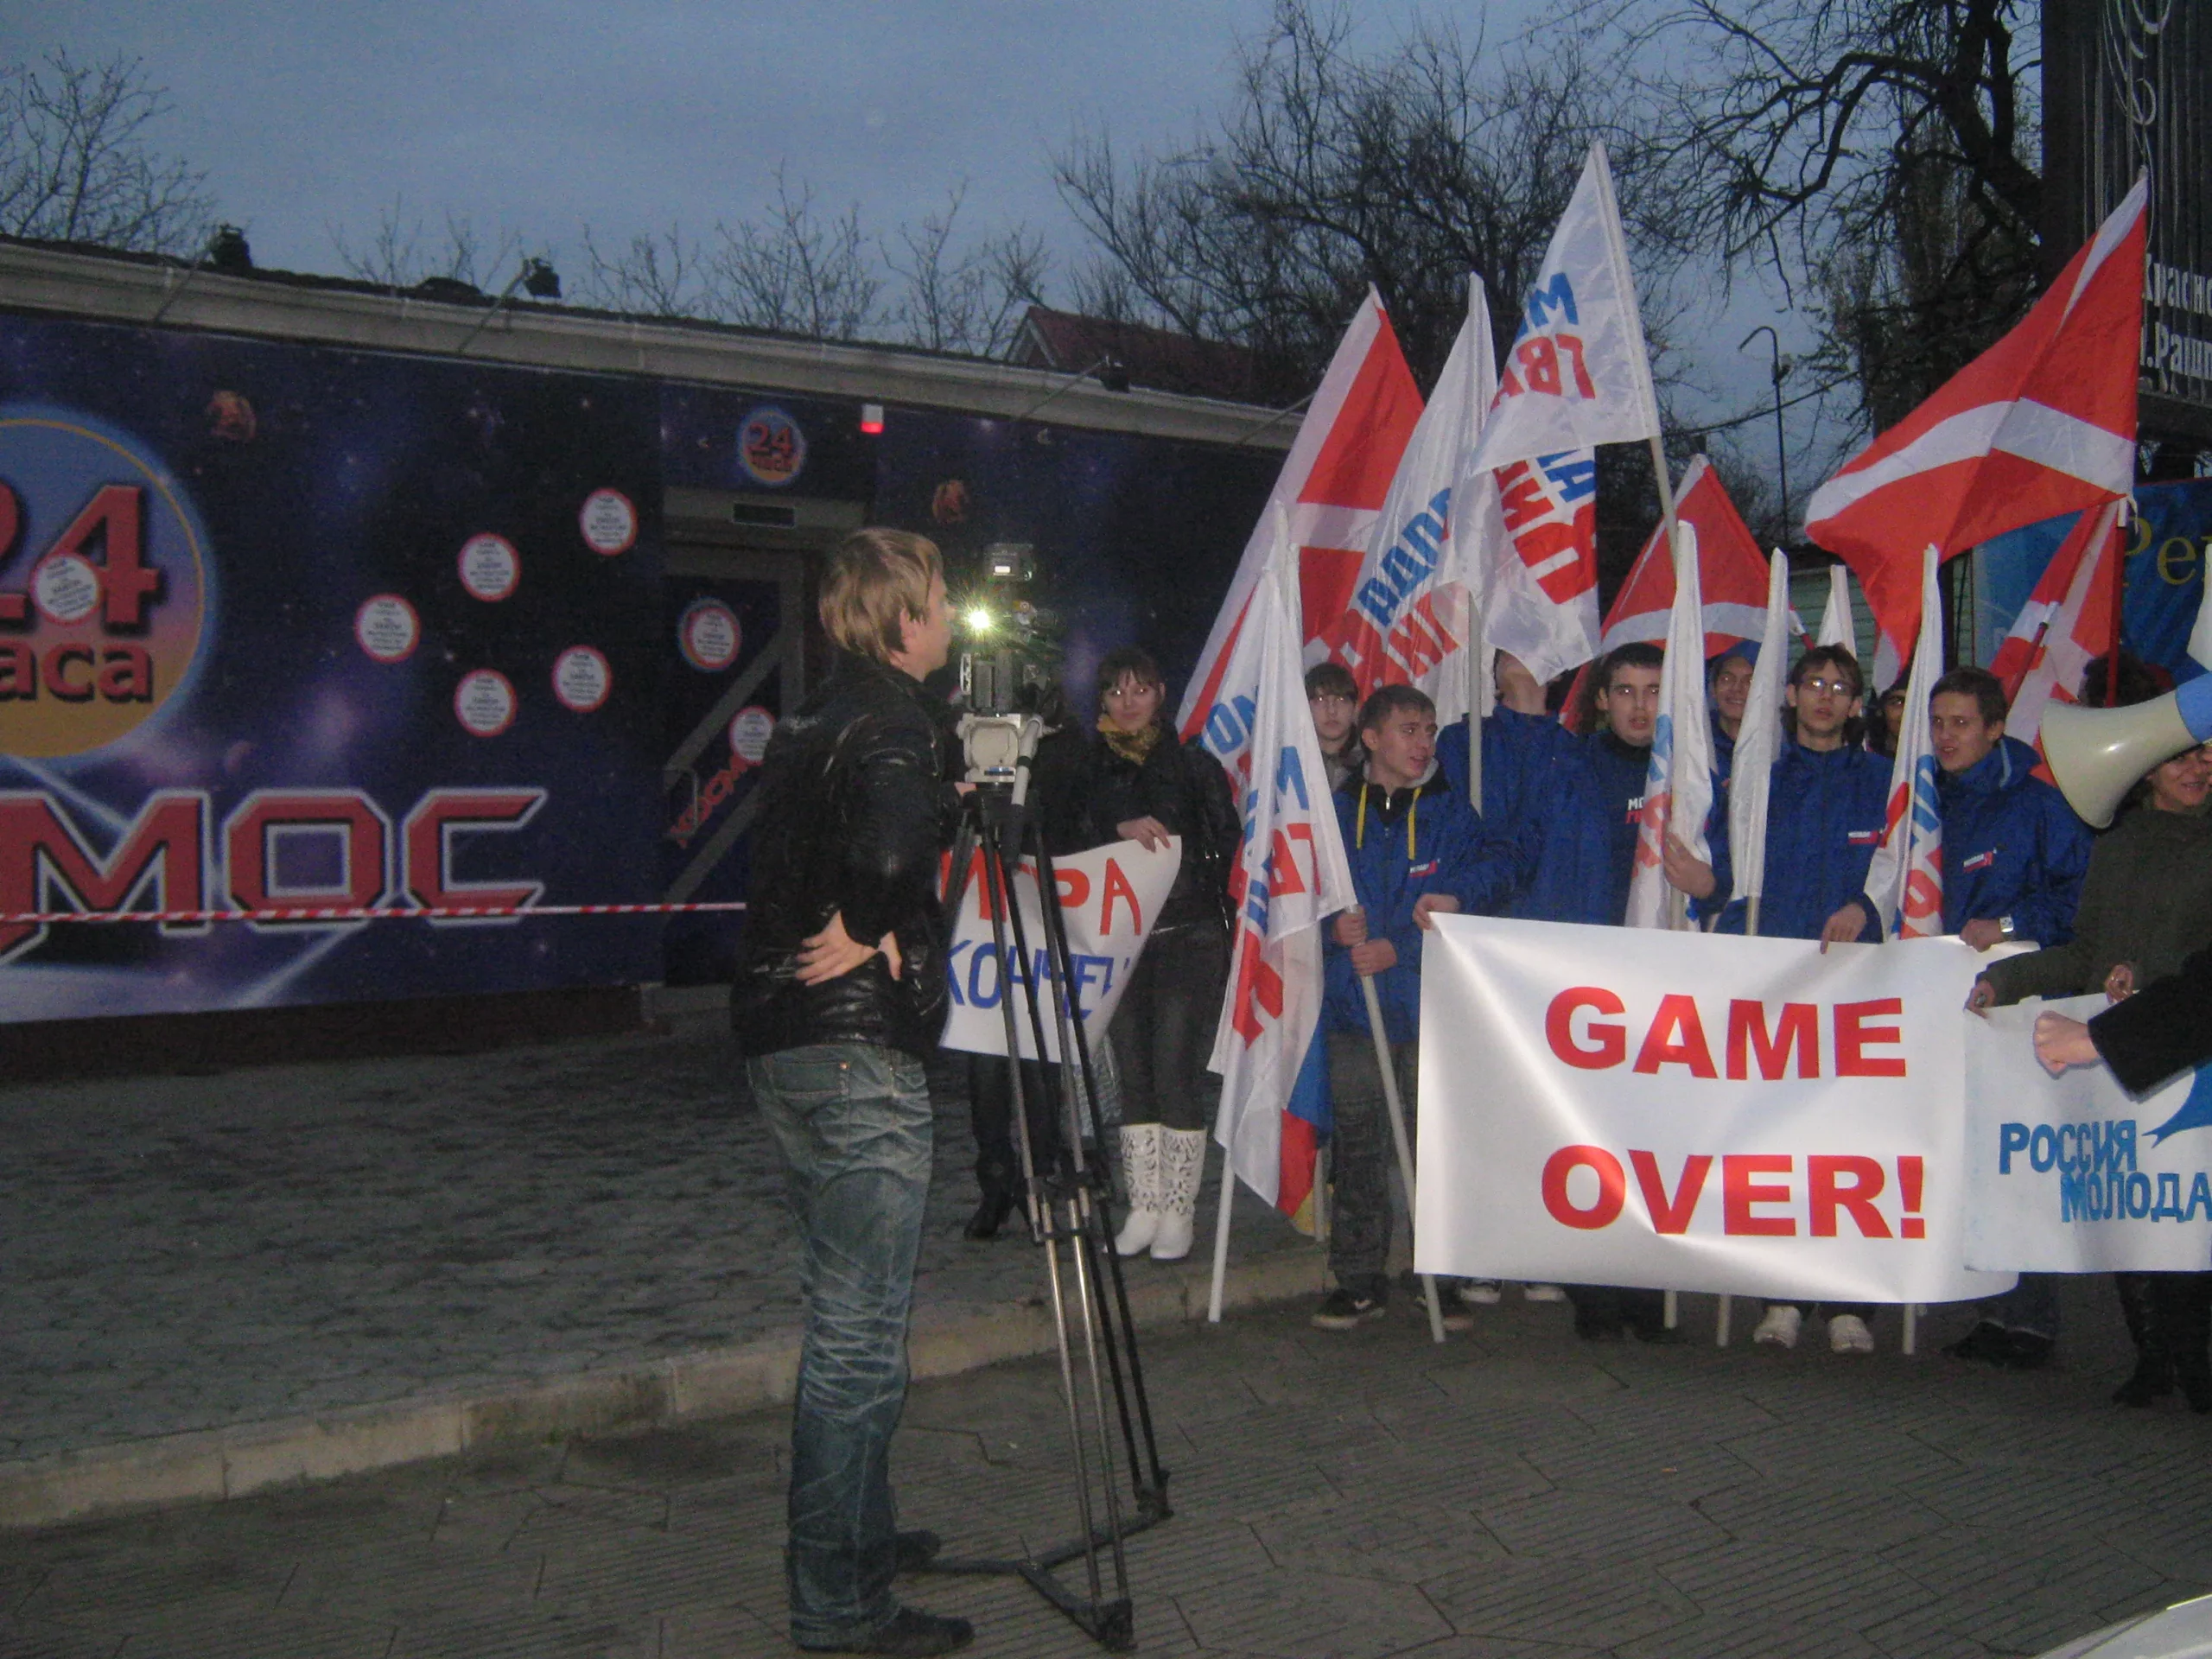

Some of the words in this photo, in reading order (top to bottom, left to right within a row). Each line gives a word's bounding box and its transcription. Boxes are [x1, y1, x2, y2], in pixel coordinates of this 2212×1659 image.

[1545, 986, 1907, 1081] GAME
[1541, 1144, 1926, 1239] OVER!
[1999, 1120, 2138, 1175] РОССИЯ
